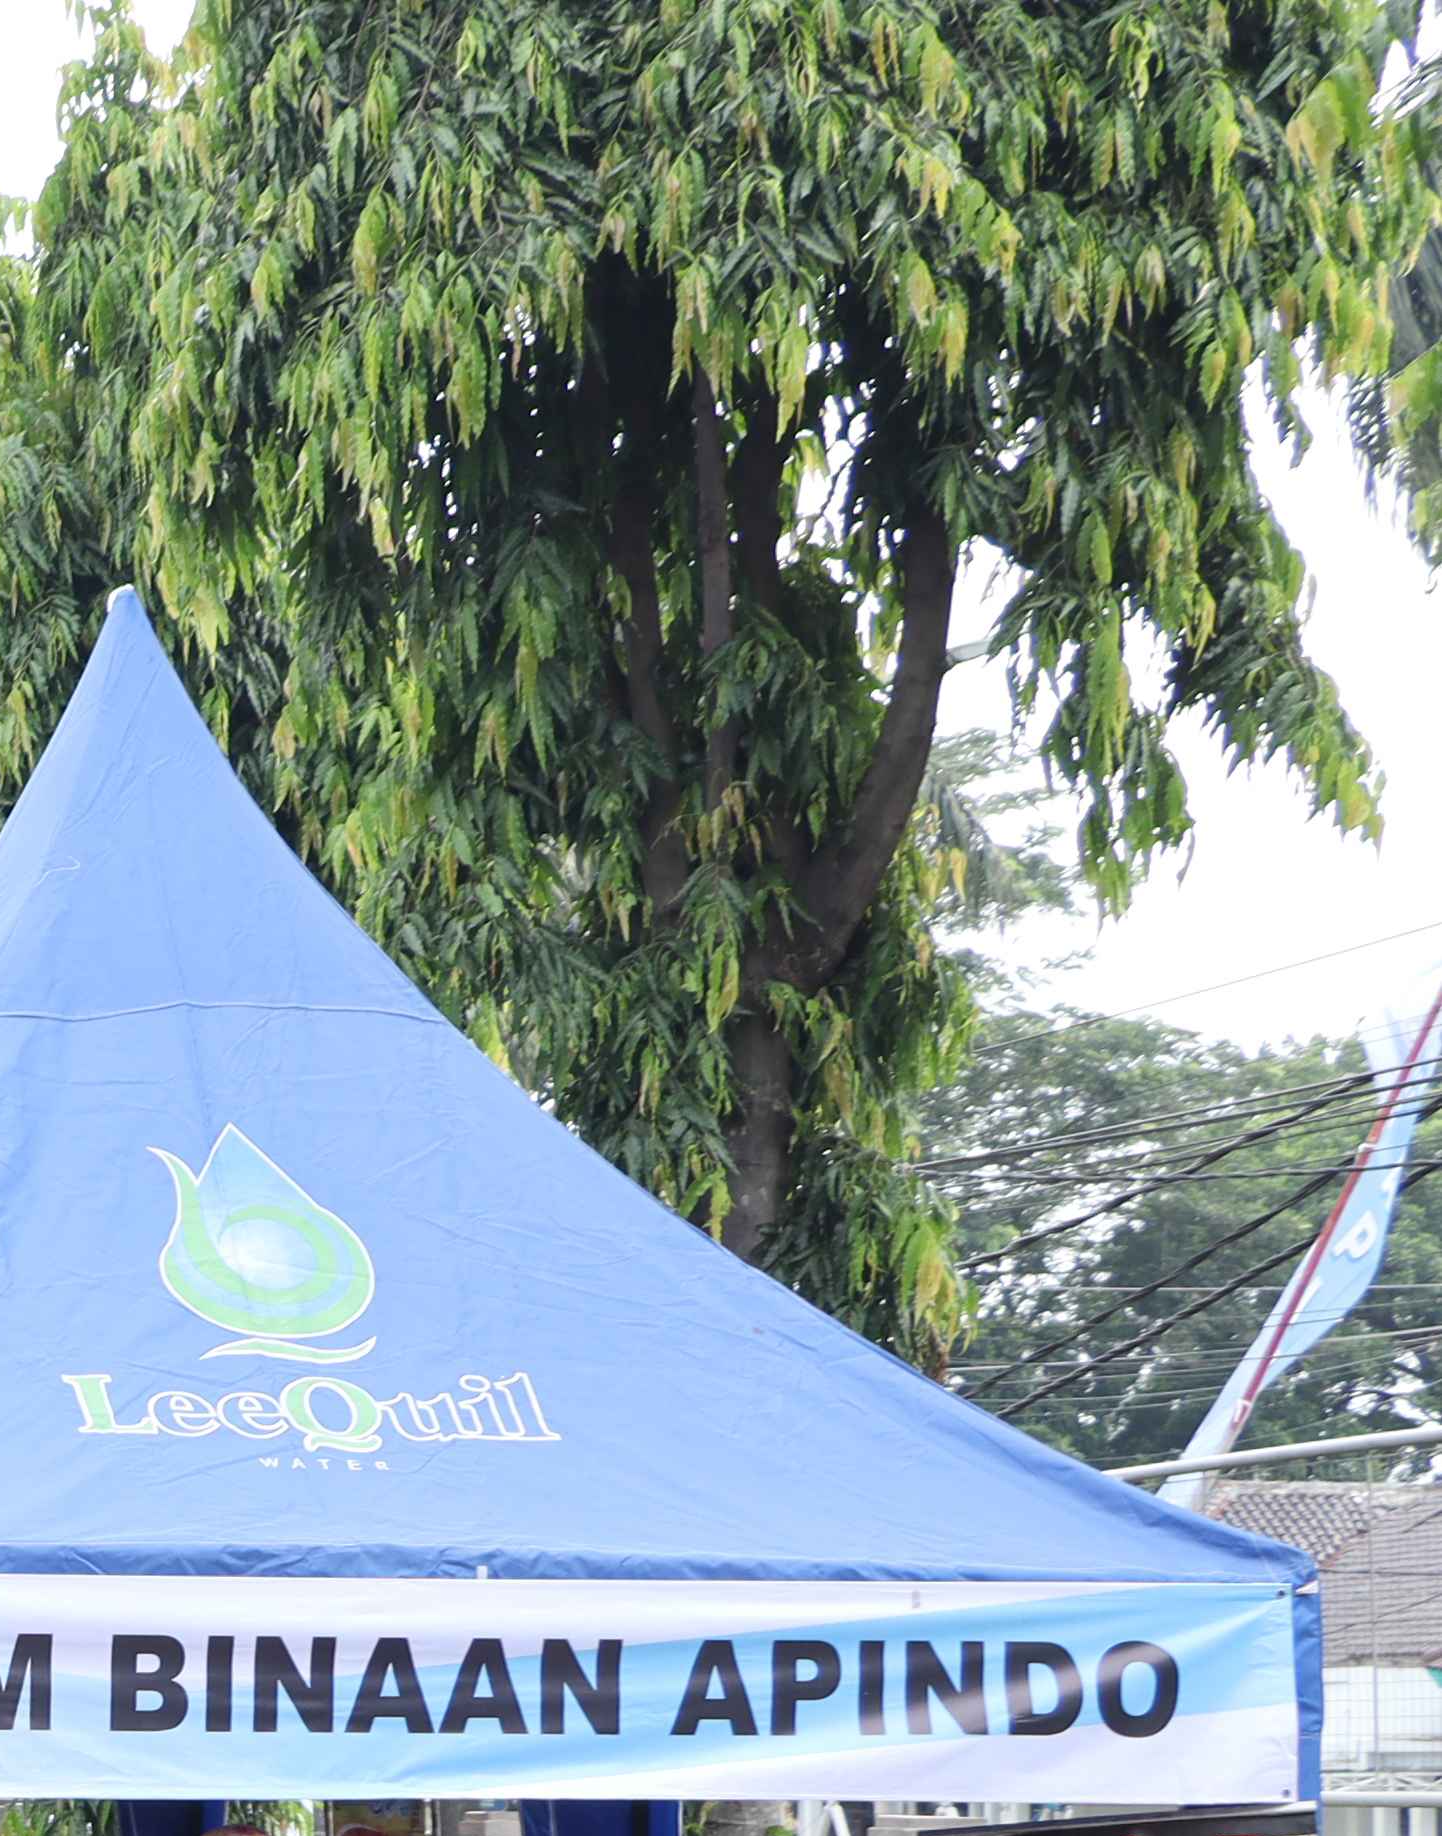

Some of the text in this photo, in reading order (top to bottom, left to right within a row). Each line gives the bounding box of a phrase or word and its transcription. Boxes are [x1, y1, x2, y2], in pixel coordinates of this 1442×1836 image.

[62, 1372, 561, 1452] LeeQuil
[259, 1456, 390, 1472] WATER
[110, 1633, 622, 1735] BINAAN
[672, 1638, 1178, 1738] APINDO
